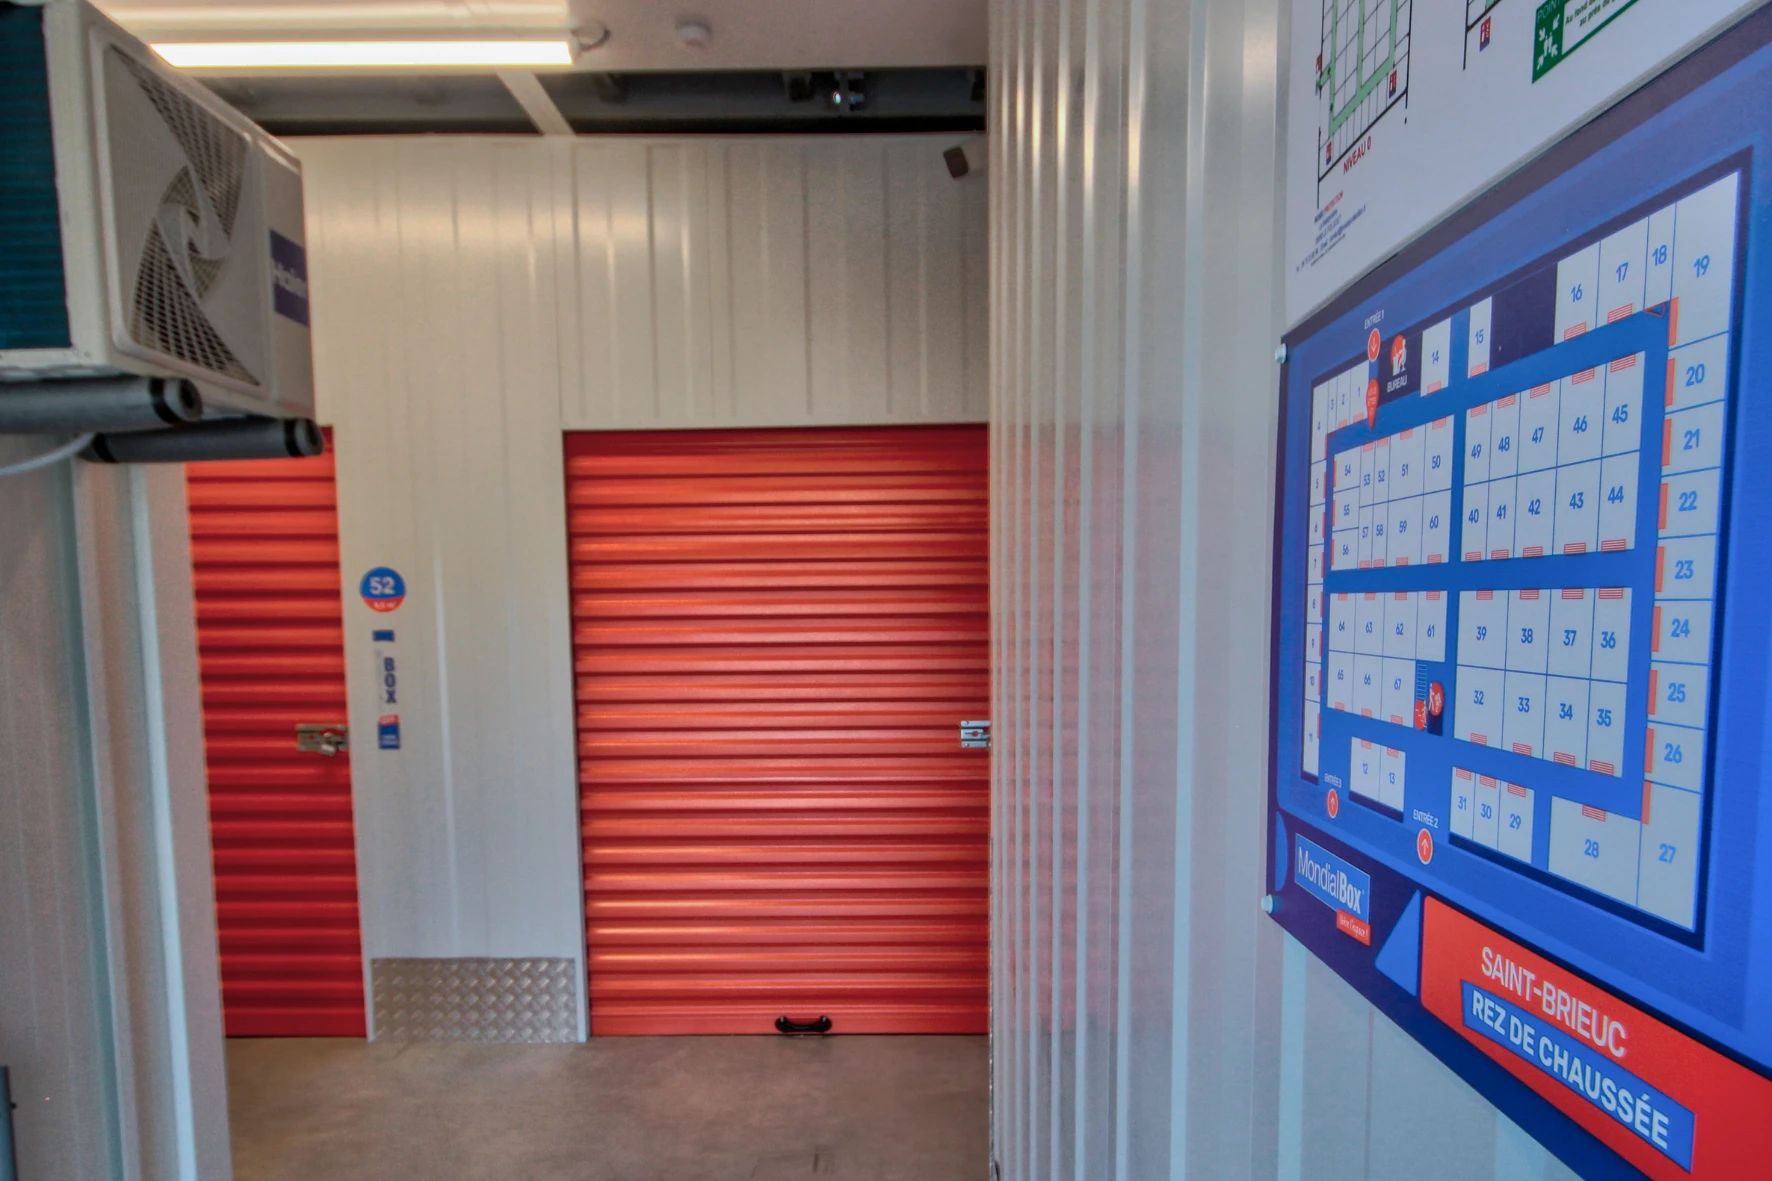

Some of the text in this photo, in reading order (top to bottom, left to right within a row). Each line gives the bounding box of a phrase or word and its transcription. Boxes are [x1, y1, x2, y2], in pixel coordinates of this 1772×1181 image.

[1343, 140, 1367, 175] NIVEAU
[1652, 245, 1667, 266] 18
[1616, 262, 1628, 283] 17
[1694, 255, 1710, 277] 19
[1571, 284, 1582, 302] 16
[1364, 309, 1381, 330] ENTRÉE
[1475, 329, 1484, 344] 15
[1432, 350, 1439, 364] 14
[1686, 364, 1705, 386] 20
[1387, 374, 1408, 393] BUREAU
[1612, 404, 1628, 423] 45
[1573, 416, 1587, 433] 46
[1532, 427, 1544, 443] 47
[1683, 429, 1700, 450] 21
[1471, 444, 1481, 458] 49
[1498, 436, 1510, 452] 48
[1402, 464, 1408, 476] 51
[1432, 455, 1441, 469] 50
[1345, 465, 1351, 476] 54
[1378, 470, 1385, 482] 52
[1364, 474, 1370, 486] 53
[1570, 492, 1584, 509] 43
[1608, 486, 1624, 504] 44
[1679, 491, 1697, 512] 22
[1344, 504, 1350, 516] 55
[1497, 505, 1506, 519] 41
[1528, 499, 1540, 515] 42
[1430, 516, 1438, 529] 60
[1468, 509, 1479, 523] 40
[1362, 526, 1369, 538] 57
[1376, 524, 1383, 536] 58
[1400, 520, 1407, 533] 59
[1343, 544, 1349, 555] 56
[1675, 560, 1693, 579] 23
[369, 576, 396, 596] 52
[1339, 621, 1345, 631] 64
[1366, 622, 1372, 633] 63
[1396, 623, 1403, 635] 62
[1427, 625, 1434, 637] 61
[1477, 626, 1486, 640] 39
[1671, 618, 1690, 637] 24
[1521, 628, 1533, 643] 38
[1563, 630, 1576, 646] 37
[1601, 632, 1616, 649] 36
[383, 657, 397, 704] BOX
[1337, 669, 1344, 680] 65
[1364, 674, 1371, 685] 66
[1394, 678, 1401, 690] 67
[1474, 690, 1484, 705] 32
[1668, 683, 1686, 703] 25
[1518, 697, 1530, 712] 33
[1559, 703, 1573, 720] 34
[1597, 709, 1611, 727] 35
[1664, 743, 1682, 763] 26
[1363, 763, 1368, 775] 12
[1389, 772, 1395, 784] 13
[1458, 796, 1467, 810] 31
[1481, 803, 1491, 819] 30
[1413, 808, 1439, 829] ENTRÉE 2
[1510, 814, 1521, 829] 29
[1584, 839, 1599, 858] 28
[1659, 843, 1676, 863] 27
[1298, 846, 1362, 914] MondialBox
[1481, 947, 1627, 1057] SAINT-BRIEUC
[1472, 990, 1669, 1149] REZ DE CHAUSSÉE
